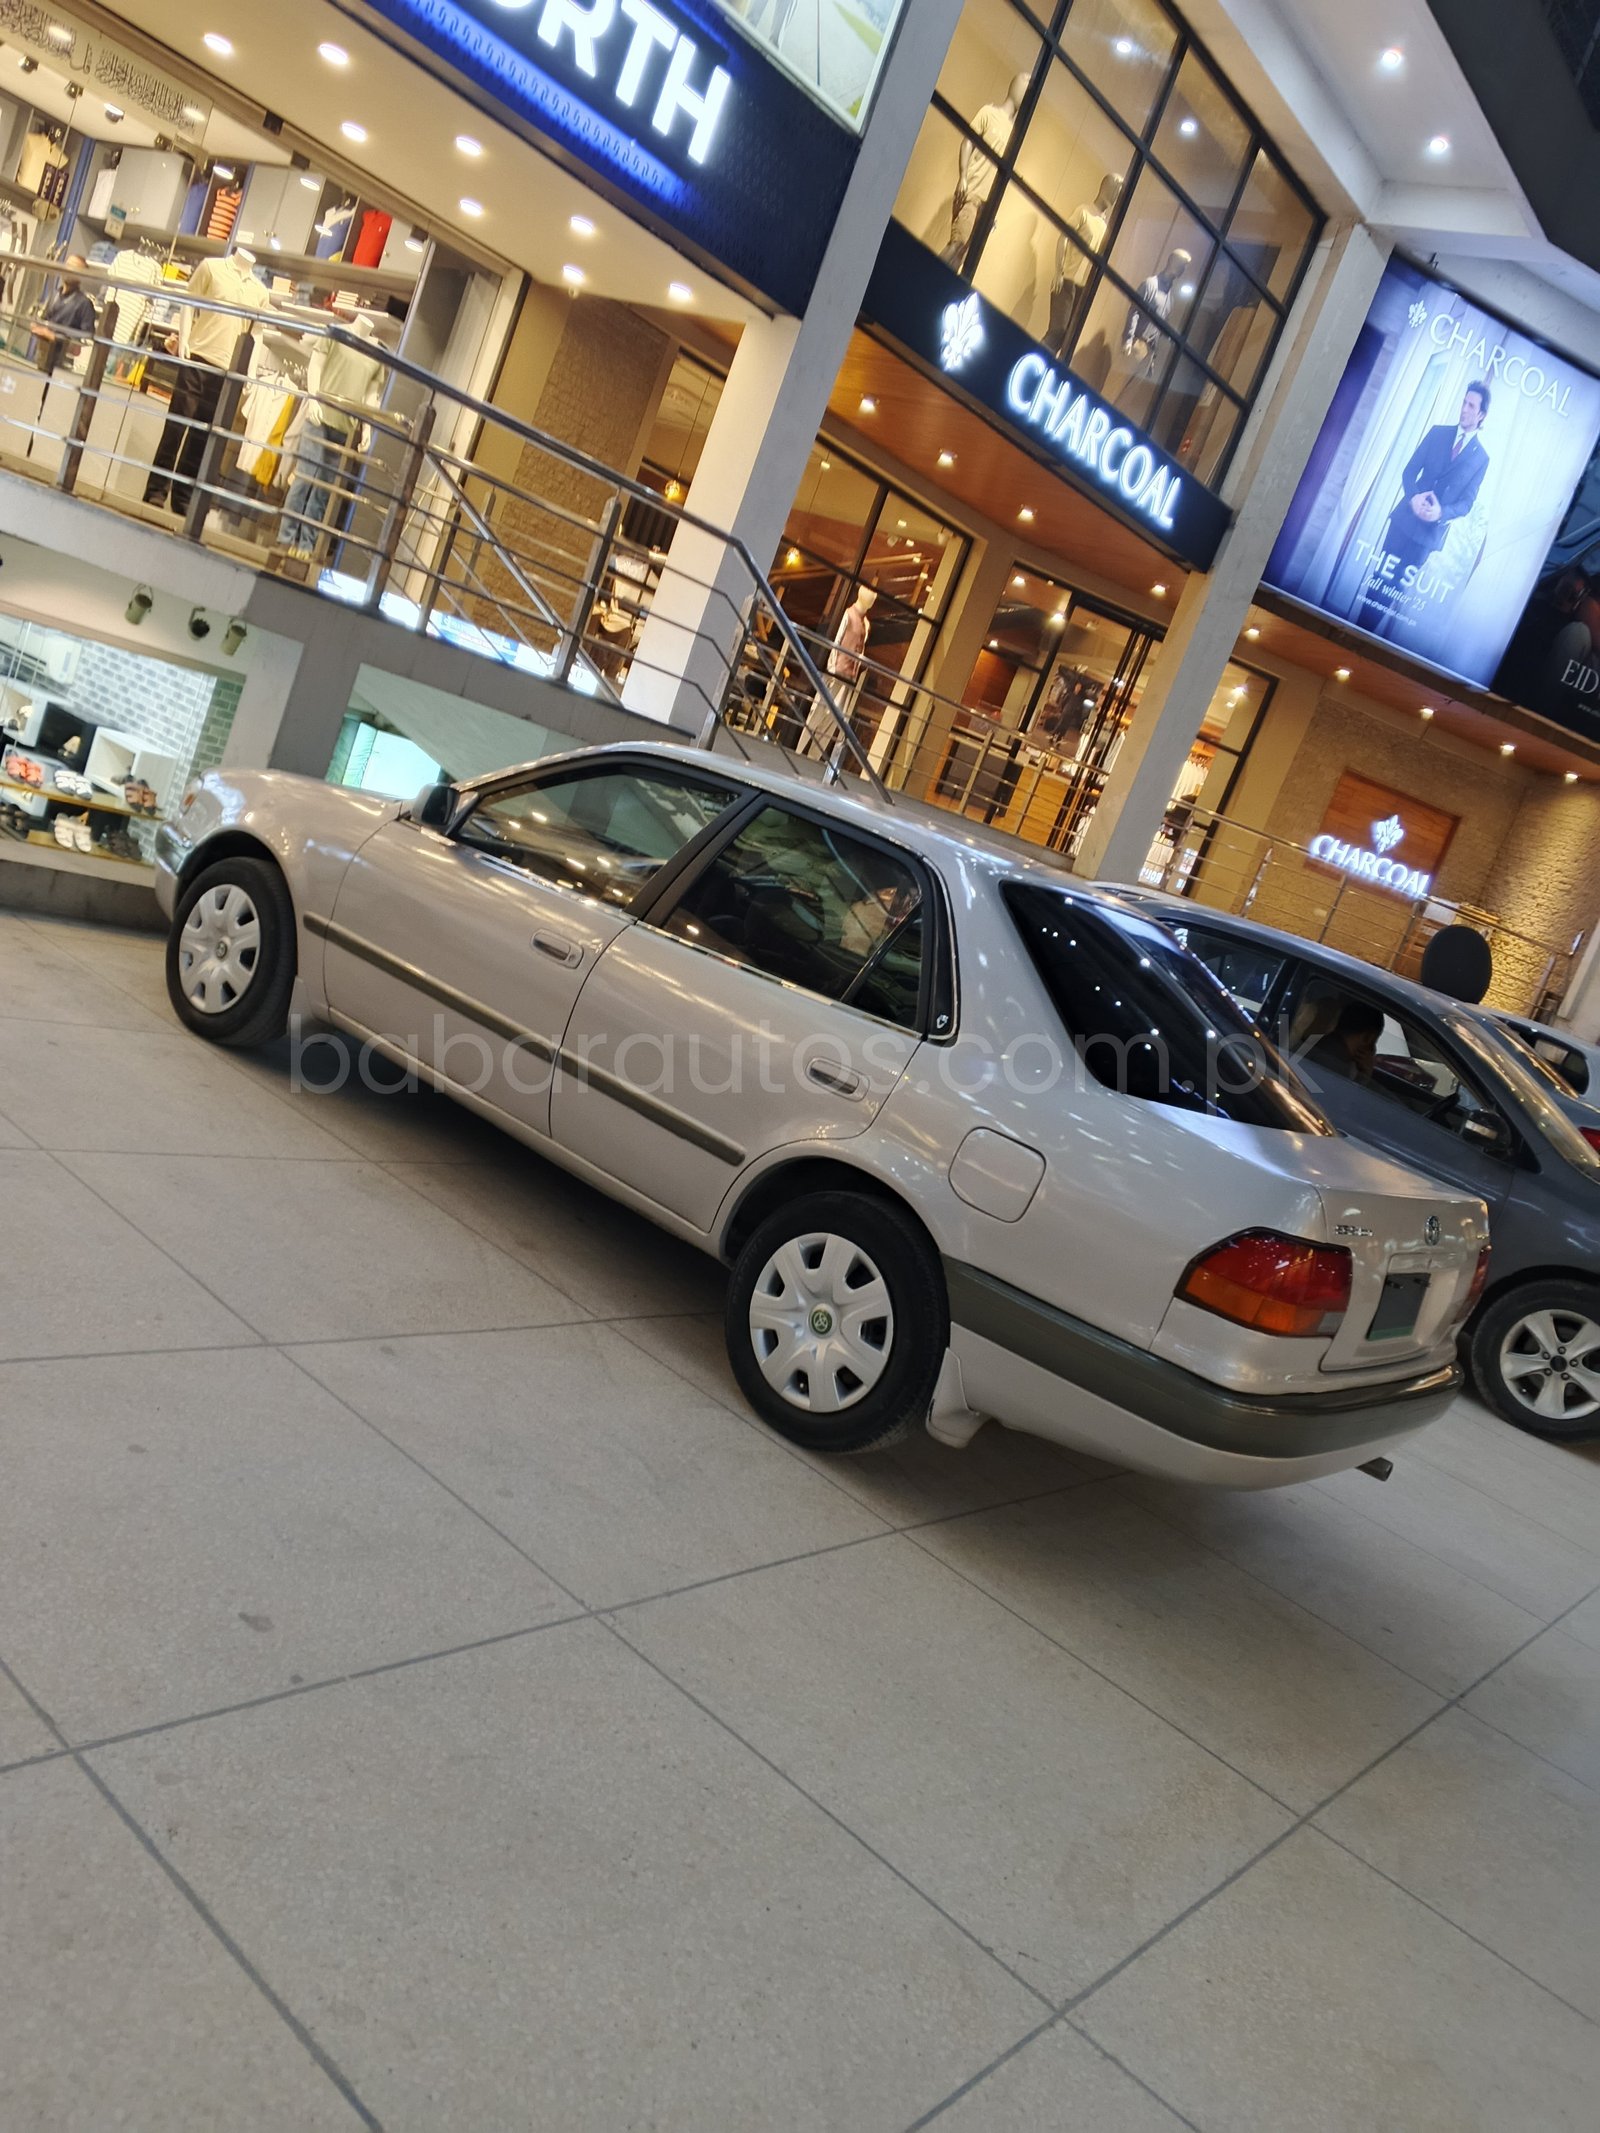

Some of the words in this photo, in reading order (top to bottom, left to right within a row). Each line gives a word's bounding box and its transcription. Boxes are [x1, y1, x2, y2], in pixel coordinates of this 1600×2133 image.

[494, 0, 731, 164] RTH
[1430, 313, 1571, 417] CHARCOAL
[1008, 353, 1182, 530] CHARCOAL
[1355, 539, 1401, 580] THE
[1400, 564, 1455, 604] SUIT
[1362, 574, 1384, 591] fall
[1382, 583, 1413, 605] winter
[1560, 658, 1600, 694] EID
[1310, 834, 1431, 897] CHARCOAL
